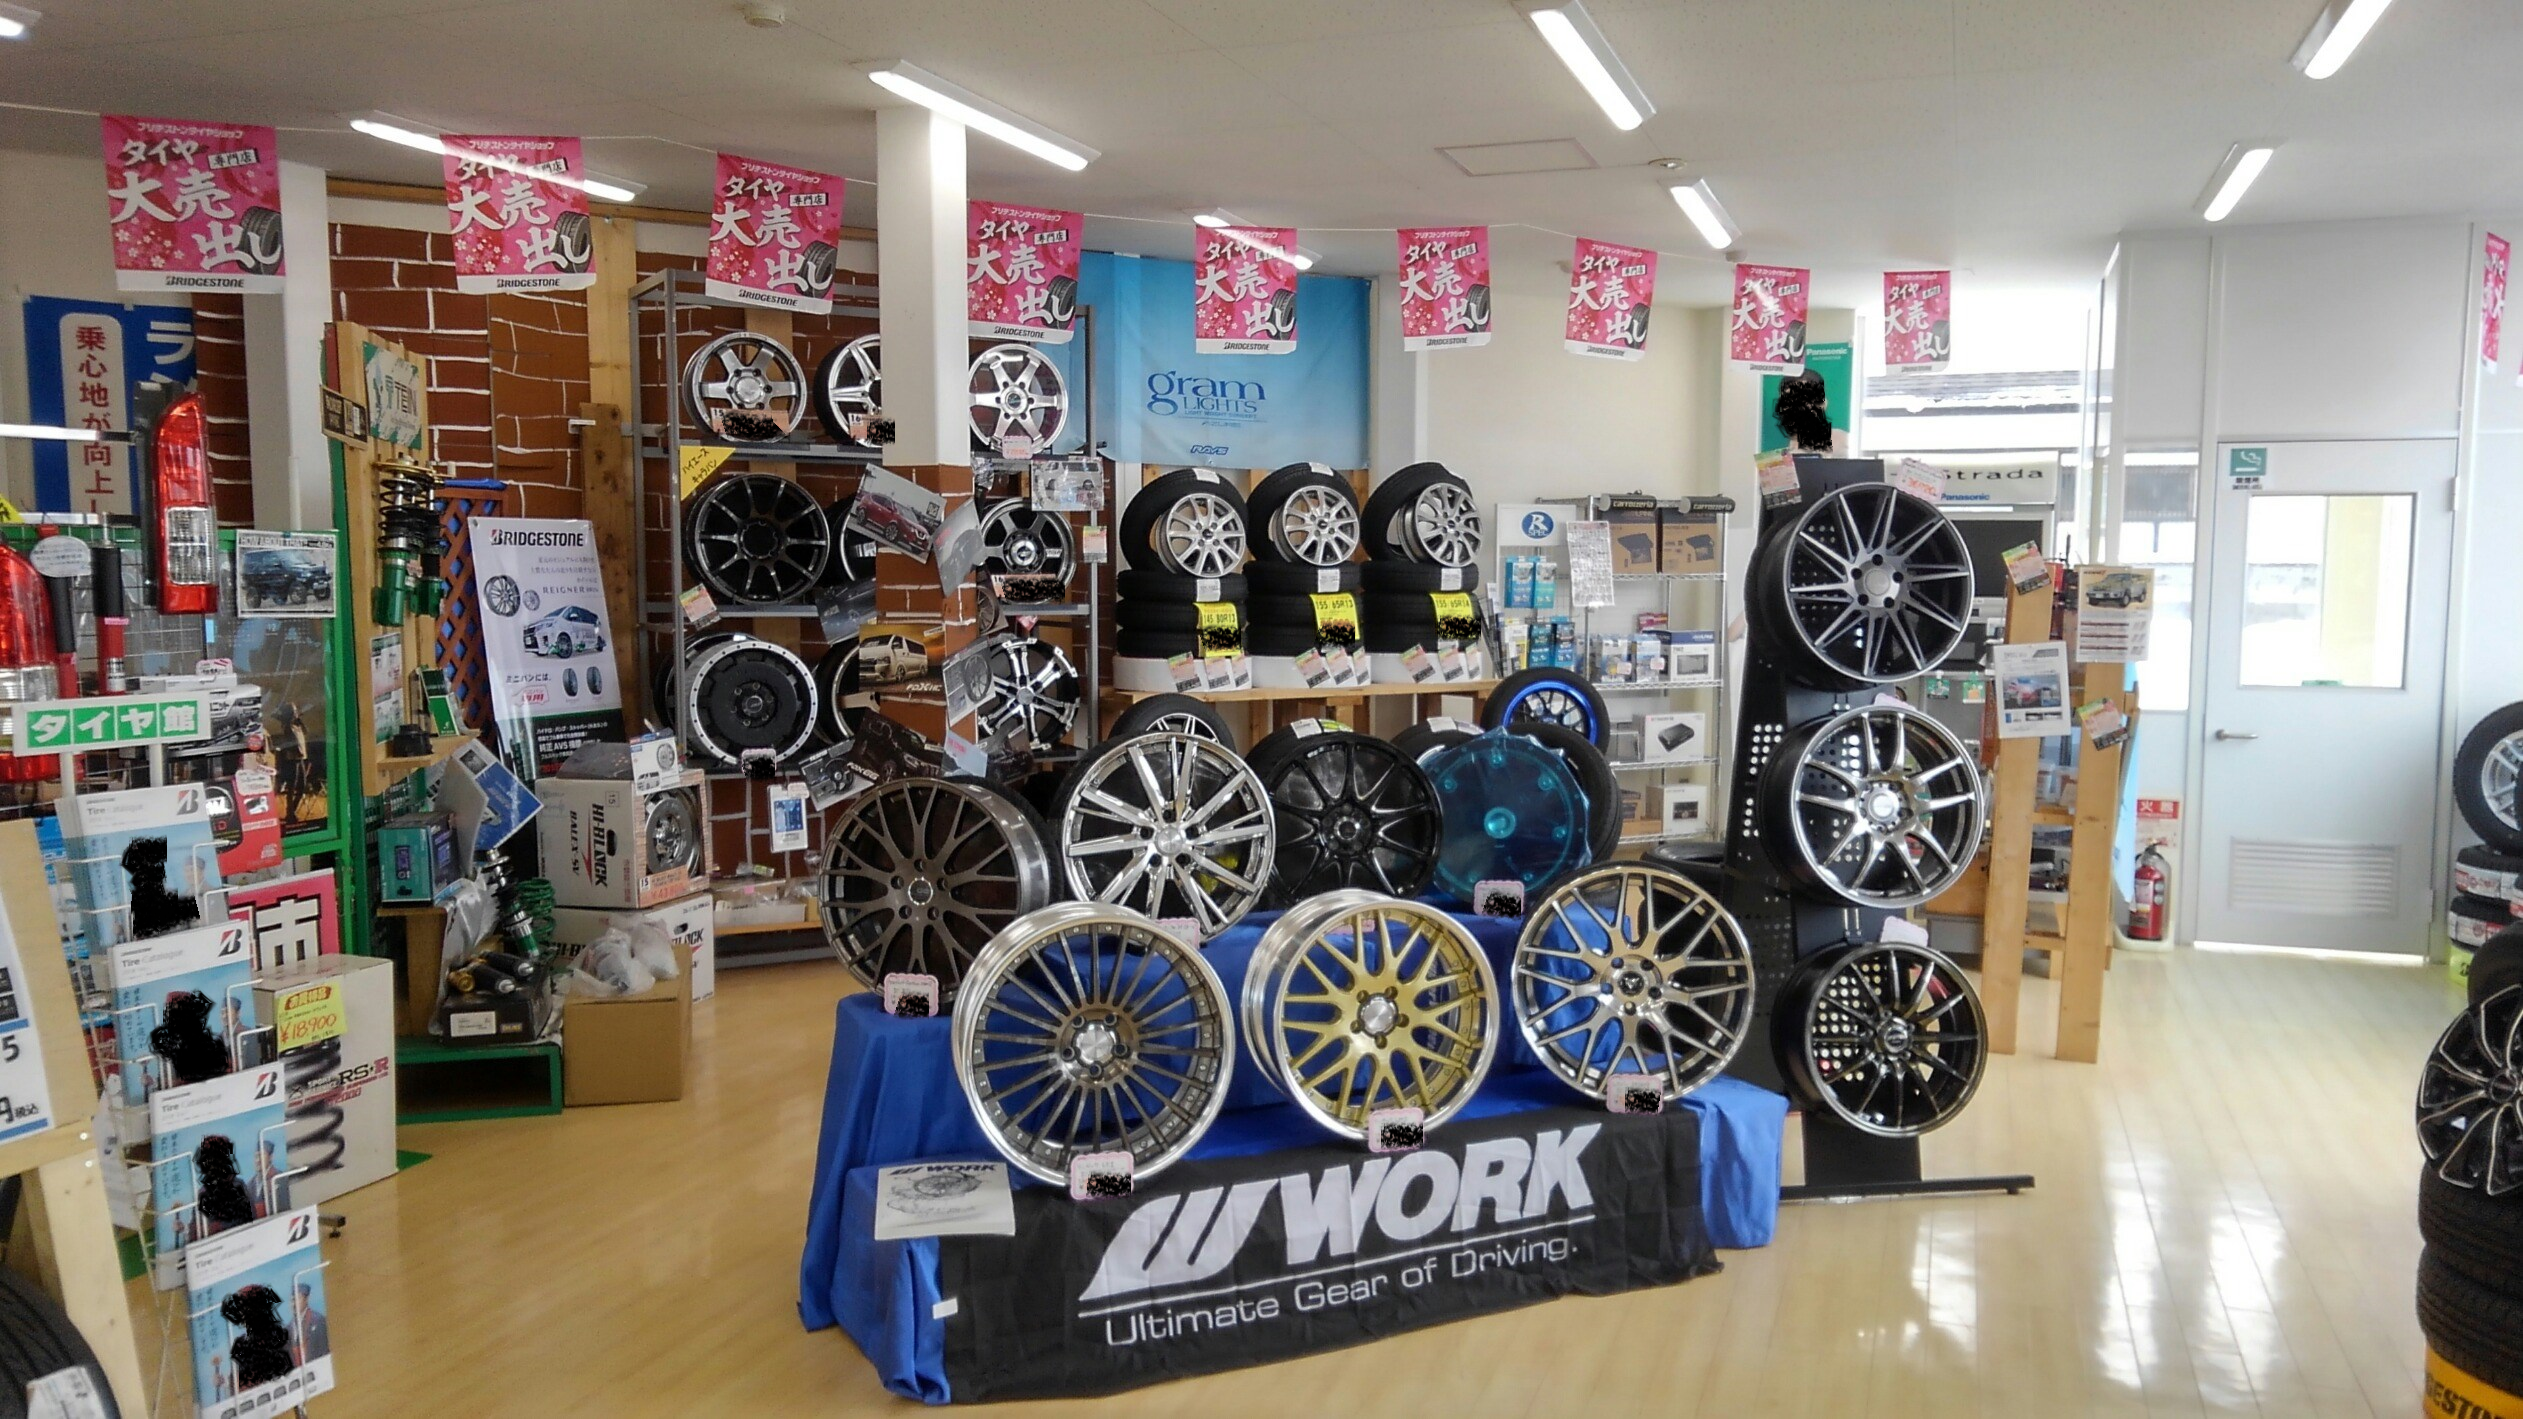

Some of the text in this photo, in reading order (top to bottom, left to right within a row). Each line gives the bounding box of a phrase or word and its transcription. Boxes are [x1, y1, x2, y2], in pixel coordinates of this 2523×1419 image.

[122, 138, 253, 167] タイヤ 専門店
[108, 167, 236, 224] 大売
[725, 175, 824, 206] タイヤ 専門店
[448, 179, 550, 234] 大売
[709, 201, 801, 249] 大売
[980, 219, 1030, 241] タイヤ
[192, 220, 282, 271] 出し
[516, 226, 591, 273] 出し
[1206, 240, 1251, 261] タイヤ
[1406, 241, 1447, 264] タイヤ
[764, 249, 833, 291] 出し
[967, 243, 1046, 286] 大売
[1581, 254, 1620, 274] タイヤ
[166, 276, 244, 288] BRIDGESTONE
[497, 278, 560, 288] BRIDGESTONE
[1196, 261, 1269, 304] 大売
[1400, 261, 1463, 305] 大売
[1569, 275, 1630, 311] 大売
[1890, 282, 1920, 301] タイヤ
[739, 289, 798, 307] BRIDGESTONE
[1014, 285, 1075, 324] 出し
[1242, 300, 1295, 337] 出し
[1441, 297, 1489, 333] 出し
[1732, 297, 1786, 331] 大売
[1885, 300, 1930, 336] 大売
[994, 326, 1045, 339] BRIDGESTONE
[1605, 310, 1647, 345] 出し
[1224, 341, 1270, 351] BRIDGESTONE
[1764, 331, 1805, 360] 出し
[1806, 348, 1848, 356] Panasonic
[1912, 331, 1950, 361] 出し
[1147, 371, 1266, 415] gram
[1183, 396, 1258, 413] LIGHTS
[713, 409, 724, 417] 15
[851, 414, 861, 423] 16
[682, 447, 710, 474] ハイエース
[1190, 444, 1229, 455] RAYS
[1613, 500, 1655, 509] carrozzeria
[1693, 502, 1733, 511] carrozzeria
[1941, 493, 1990, 501] Panasonic
[491, 529, 584, 547] BRIDGESTONE
[543, 586, 586, 594] REIGNER
[30, 704, 197, 743] タイヤ館
[87, 807, 106, 816] Tire
[640, 877, 649, 888] 15
[122, 959, 140, 968] Tire
[162, 1104, 179, 1113] Tire
[926, 1164, 997, 1172] WORK
[1280, 1123, 1602, 1266] WORK
[196, 1259, 213, 1269] Tire
[1106, 1236, 1579, 1346] Ultimate Gear of Driving.
